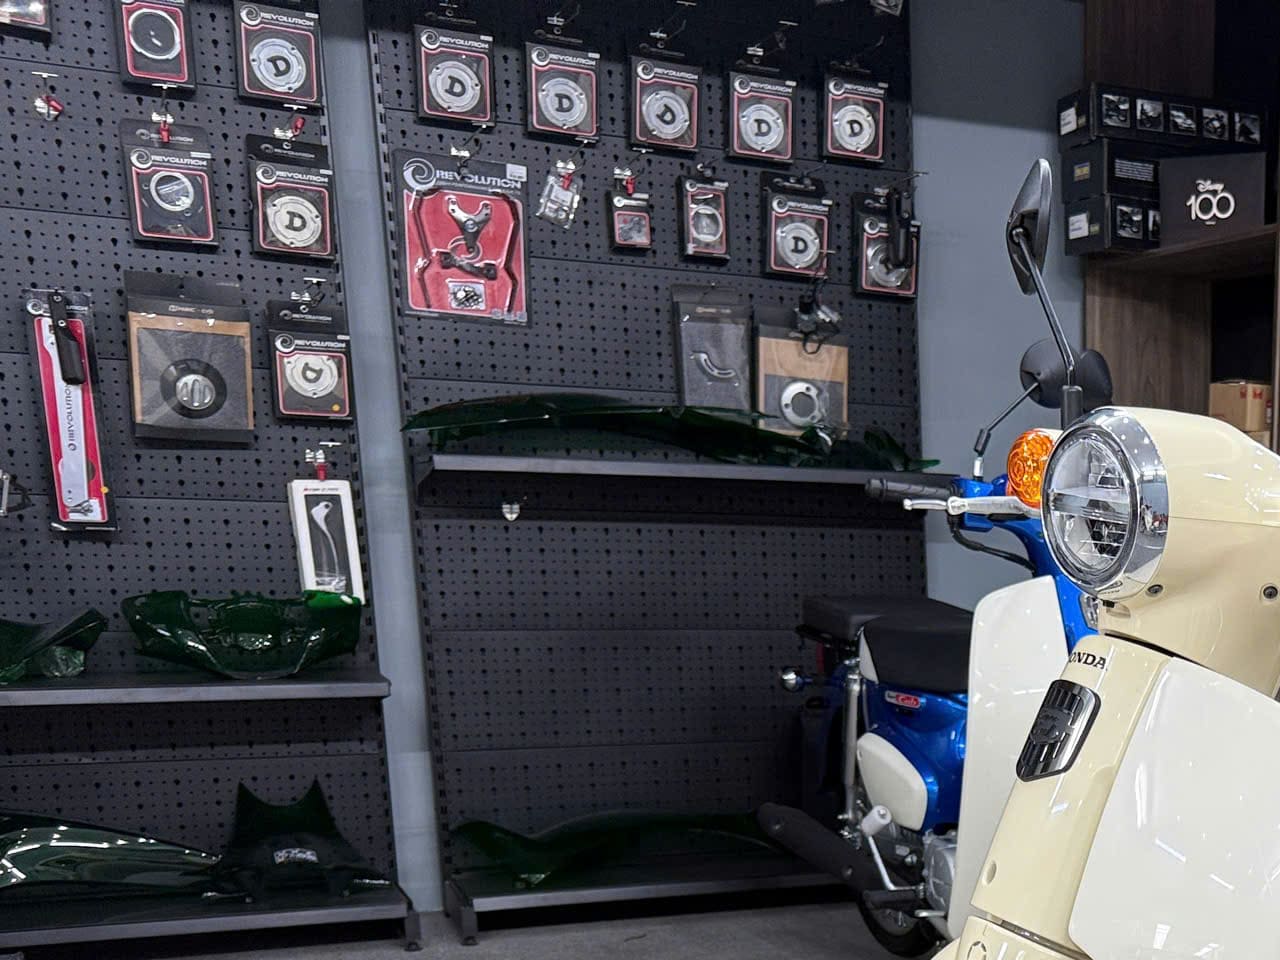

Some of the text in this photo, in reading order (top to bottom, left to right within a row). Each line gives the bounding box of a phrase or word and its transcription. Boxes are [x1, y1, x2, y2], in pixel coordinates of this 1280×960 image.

[260, 12, 314, 26] REVOLUTION
[439, 36, 489, 48] REVOLUTION
[267, 55, 290, 77] D
[445, 75, 466, 97] D
[554, 93, 575, 113] D
[753, 118, 771, 137] D
[846, 119, 863, 137] D
[151, 155, 207, 166] REVOLUTION
[276, 170, 328, 182] REVOLUTION
[436, 169, 522, 189] REVOLUTION
[1186, 193, 1235, 220] 100
[285, 210, 307, 232] D
[791, 236, 808, 254] D
[1068, 651, 1107, 671] ONDA
